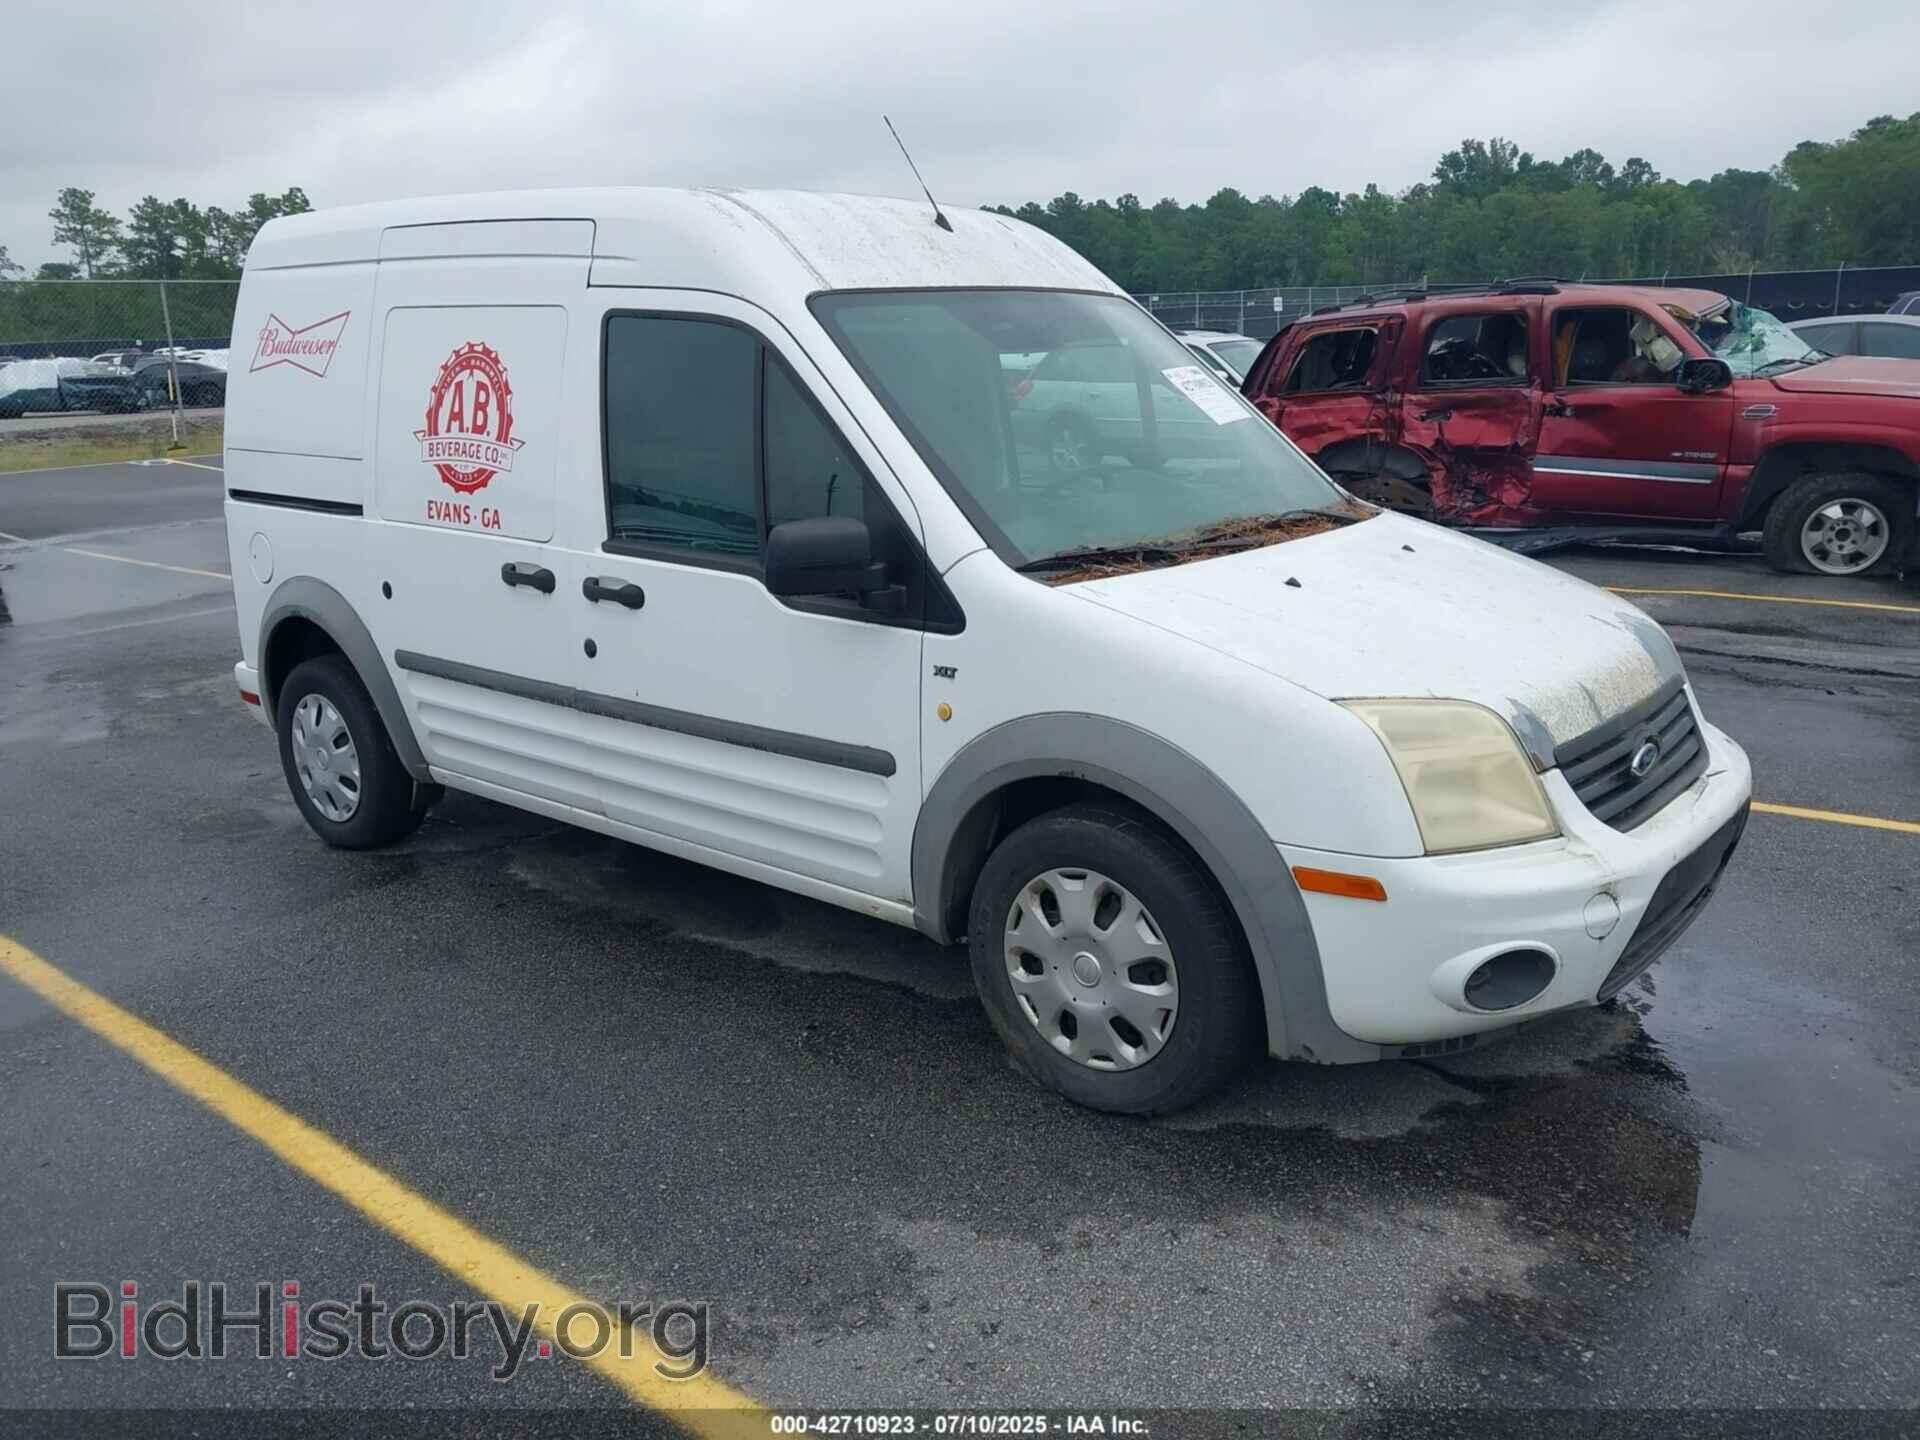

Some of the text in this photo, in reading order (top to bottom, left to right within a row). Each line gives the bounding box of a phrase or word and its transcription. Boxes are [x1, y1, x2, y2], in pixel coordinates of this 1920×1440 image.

[259, 328, 337, 357] Budweiser
[428, 441, 482, 460] BEVERAGE
[484, 446, 502, 465] CO.
[427, 500, 502, 530] EVANS GA
[933, 665, 958, 680] XLT
